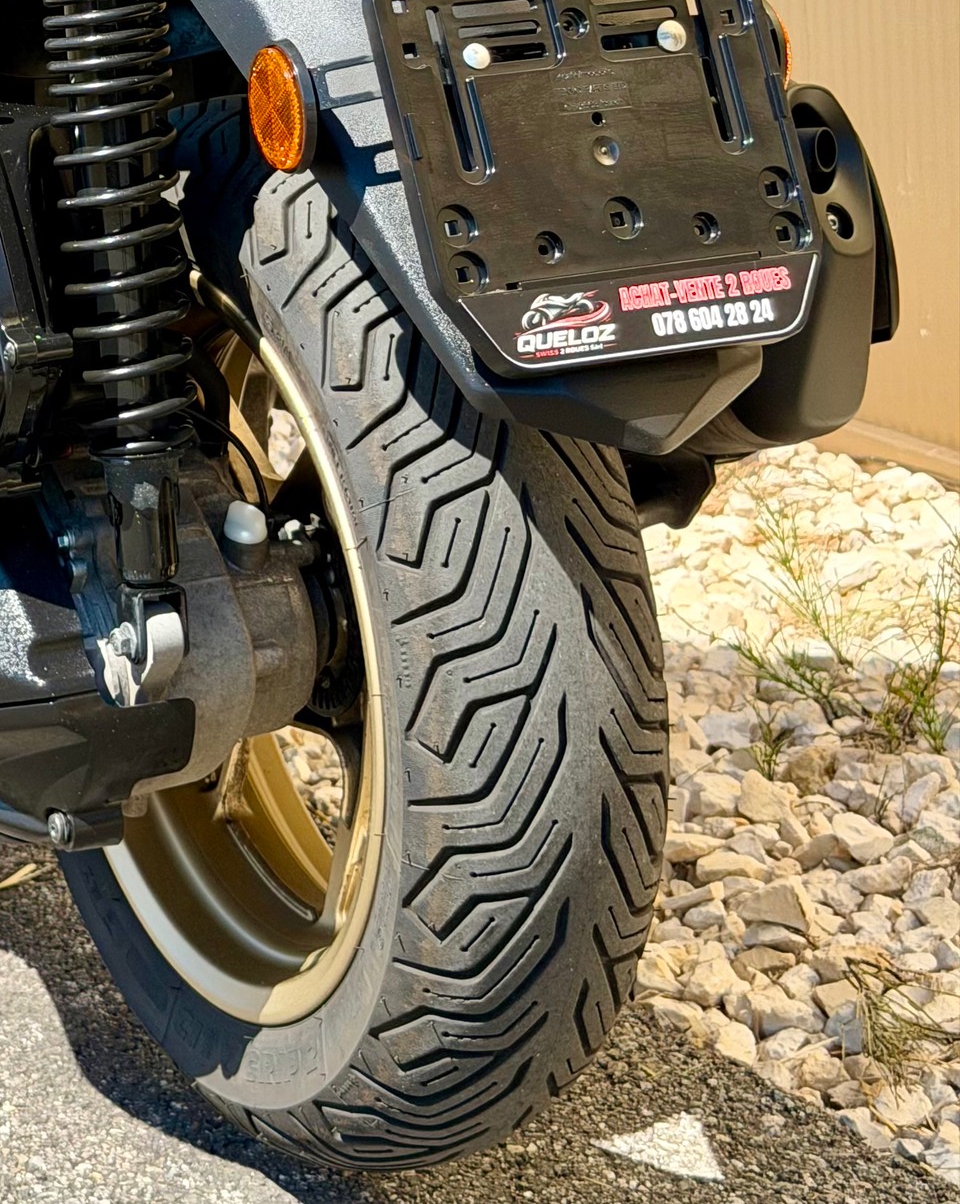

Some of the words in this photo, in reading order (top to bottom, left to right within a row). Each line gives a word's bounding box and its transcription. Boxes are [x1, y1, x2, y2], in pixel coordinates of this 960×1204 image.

[618, 274, 725, 311] ACHAT-VENTE
[724, 273, 740, 297] 2
[739, 265, 792, 295] ROUES
[651, 309, 687, 337] 078
[688, 304, 724, 332] 604
[724, 300, 749, 327] 28
[749, 297, 775, 323] 24
[517, 323, 616, 353] QUELOZ
[535, 348, 559, 358] SWISS
[565, 345, 589, 354] ROUES
